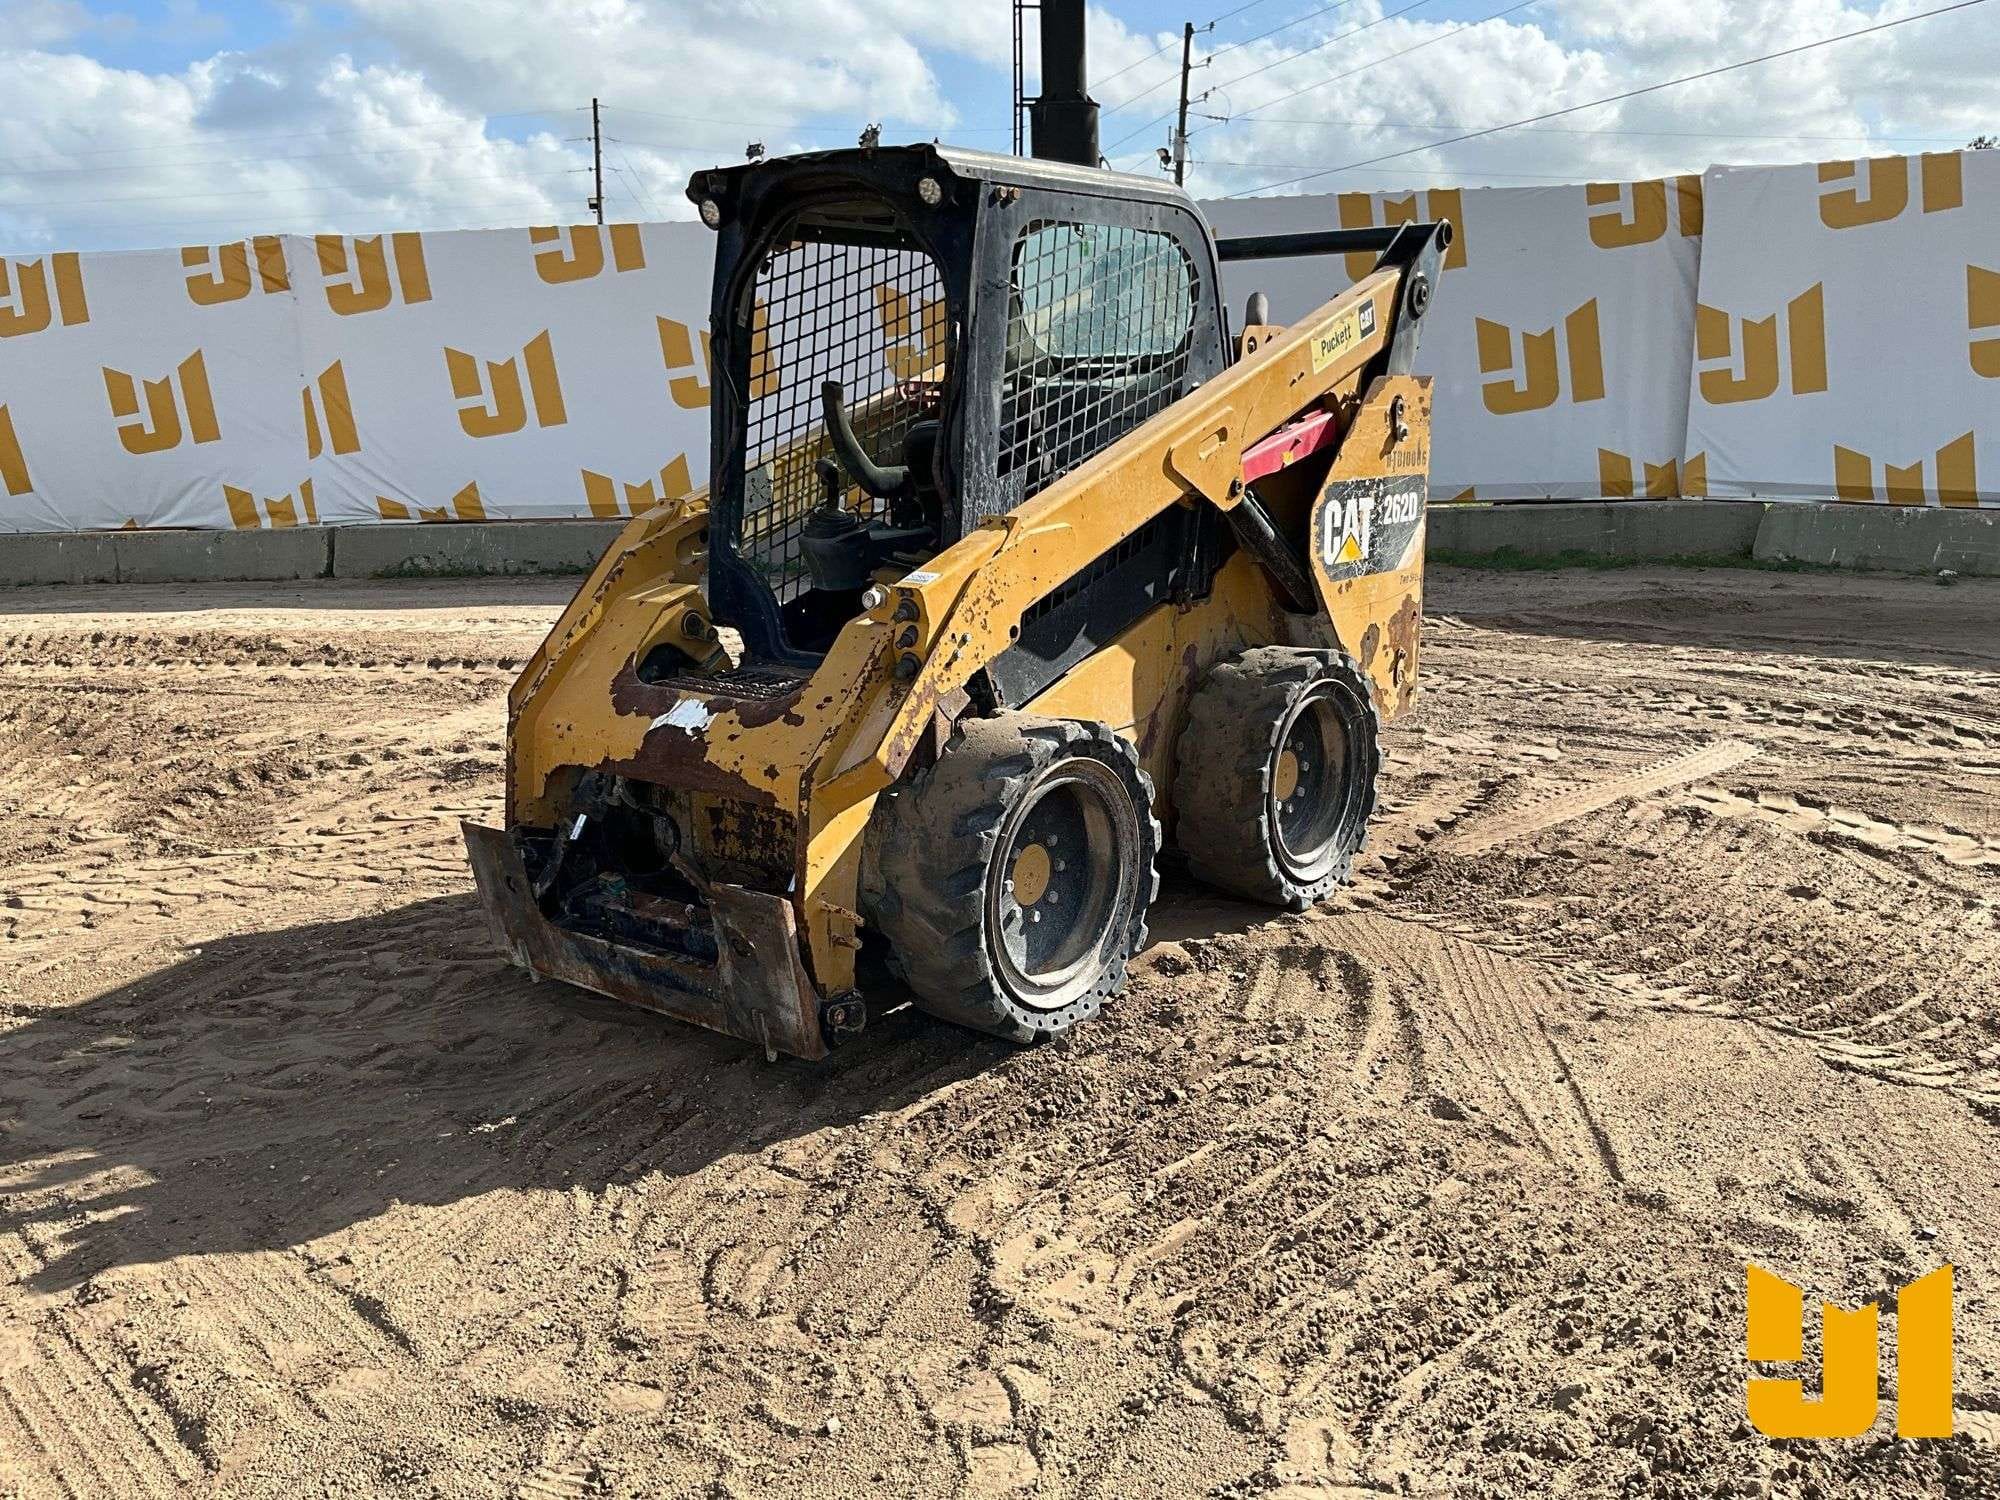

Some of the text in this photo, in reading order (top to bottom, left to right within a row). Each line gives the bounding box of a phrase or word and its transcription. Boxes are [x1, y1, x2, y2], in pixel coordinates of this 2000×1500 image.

[1321, 307, 1374, 357] Puckett CAT
[1323, 491, 1418, 566] CAT 262D
